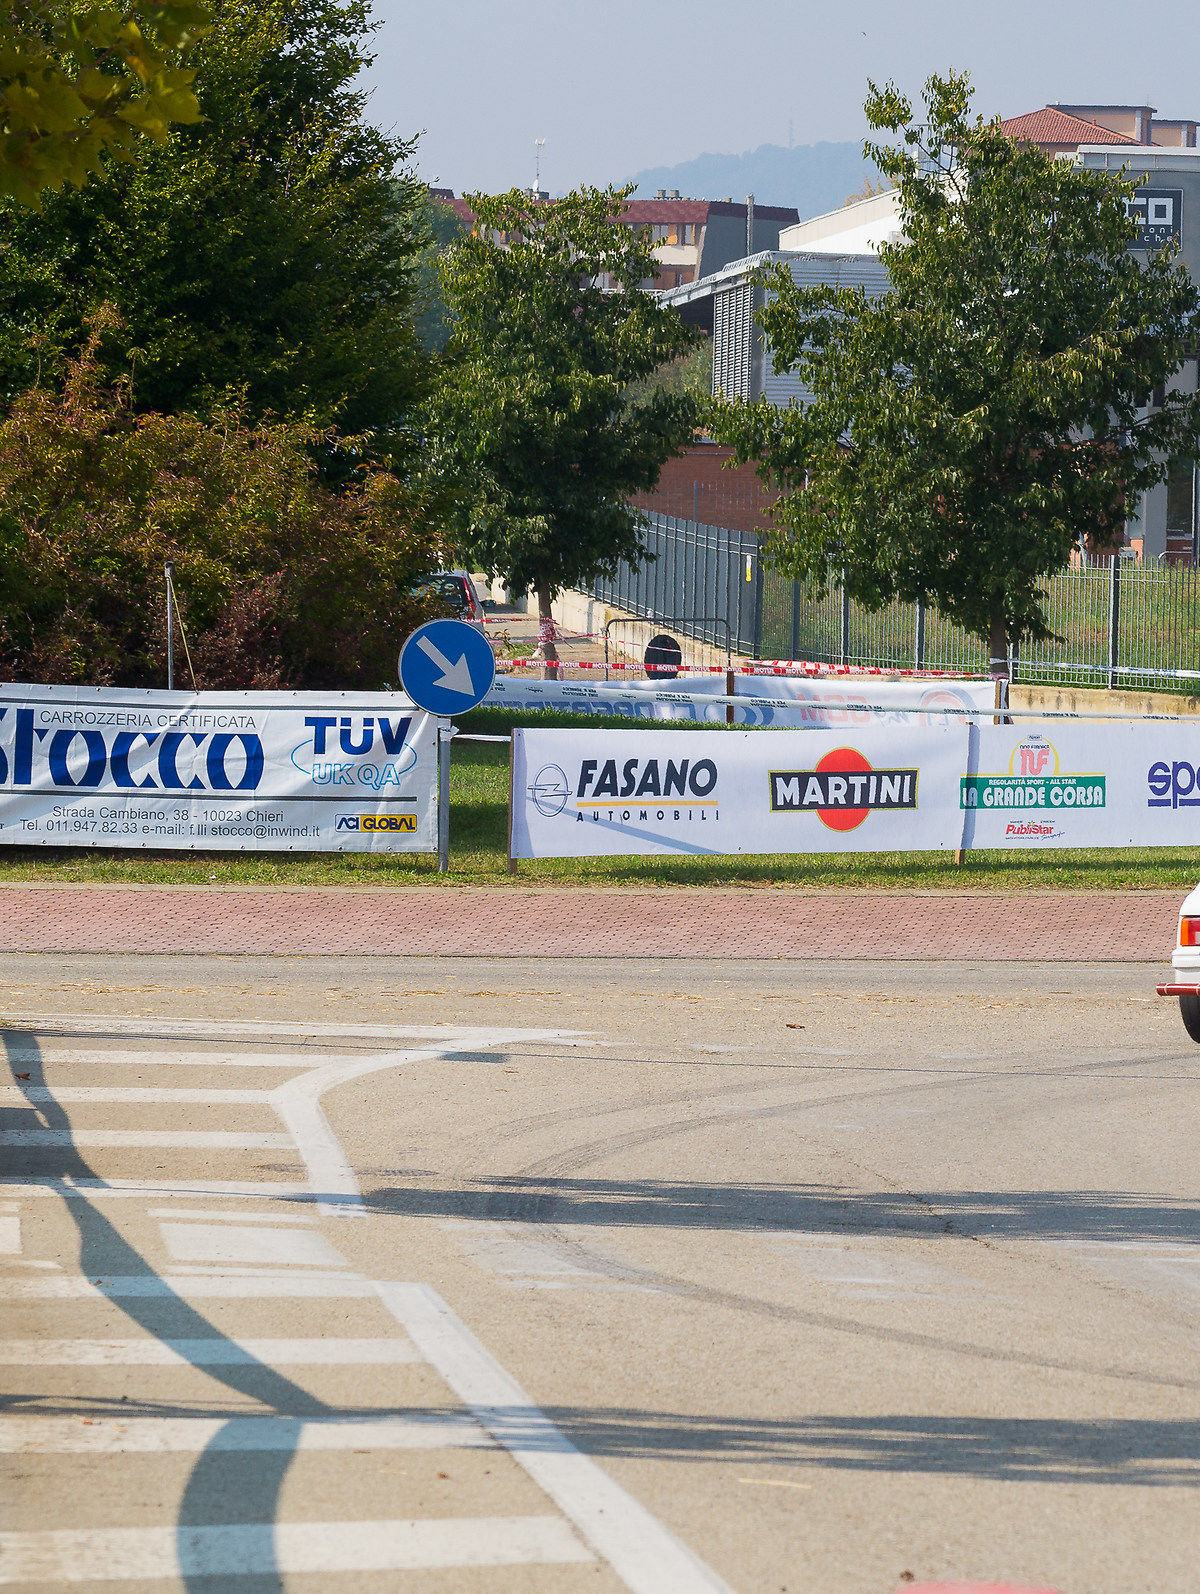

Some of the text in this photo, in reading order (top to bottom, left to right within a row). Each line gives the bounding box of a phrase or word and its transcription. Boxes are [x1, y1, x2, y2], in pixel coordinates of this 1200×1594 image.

[40, 710, 257, 729] CARROZZERIA CERTIFICATA
[304, 716, 413, 755] TÜV
[576, 758, 718, 797] FASANO
[774, 774, 913, 807] MARTINI
[962, 786, 1104, 807] LA GRANDE CORSA
[52, 806, 95, 819] Strada
[99, 807, 169, 823] Cambiano,
[173, 809, 189, 821] 38
[203, 810, 242, 822] 10023
[246, 810, 284, 822] Chieri
[336, 816, 416, 831] ACI GLOBAL
[576, 809, 720, 823] AUTOMOBILI
[20, 819, 42, 831] Tel.
[46, 820, 138, 834] 011.947.82.33
[142, 823, 185, 835] e-mail:
[211, 824, 320, 839] stocco@inwind.it
